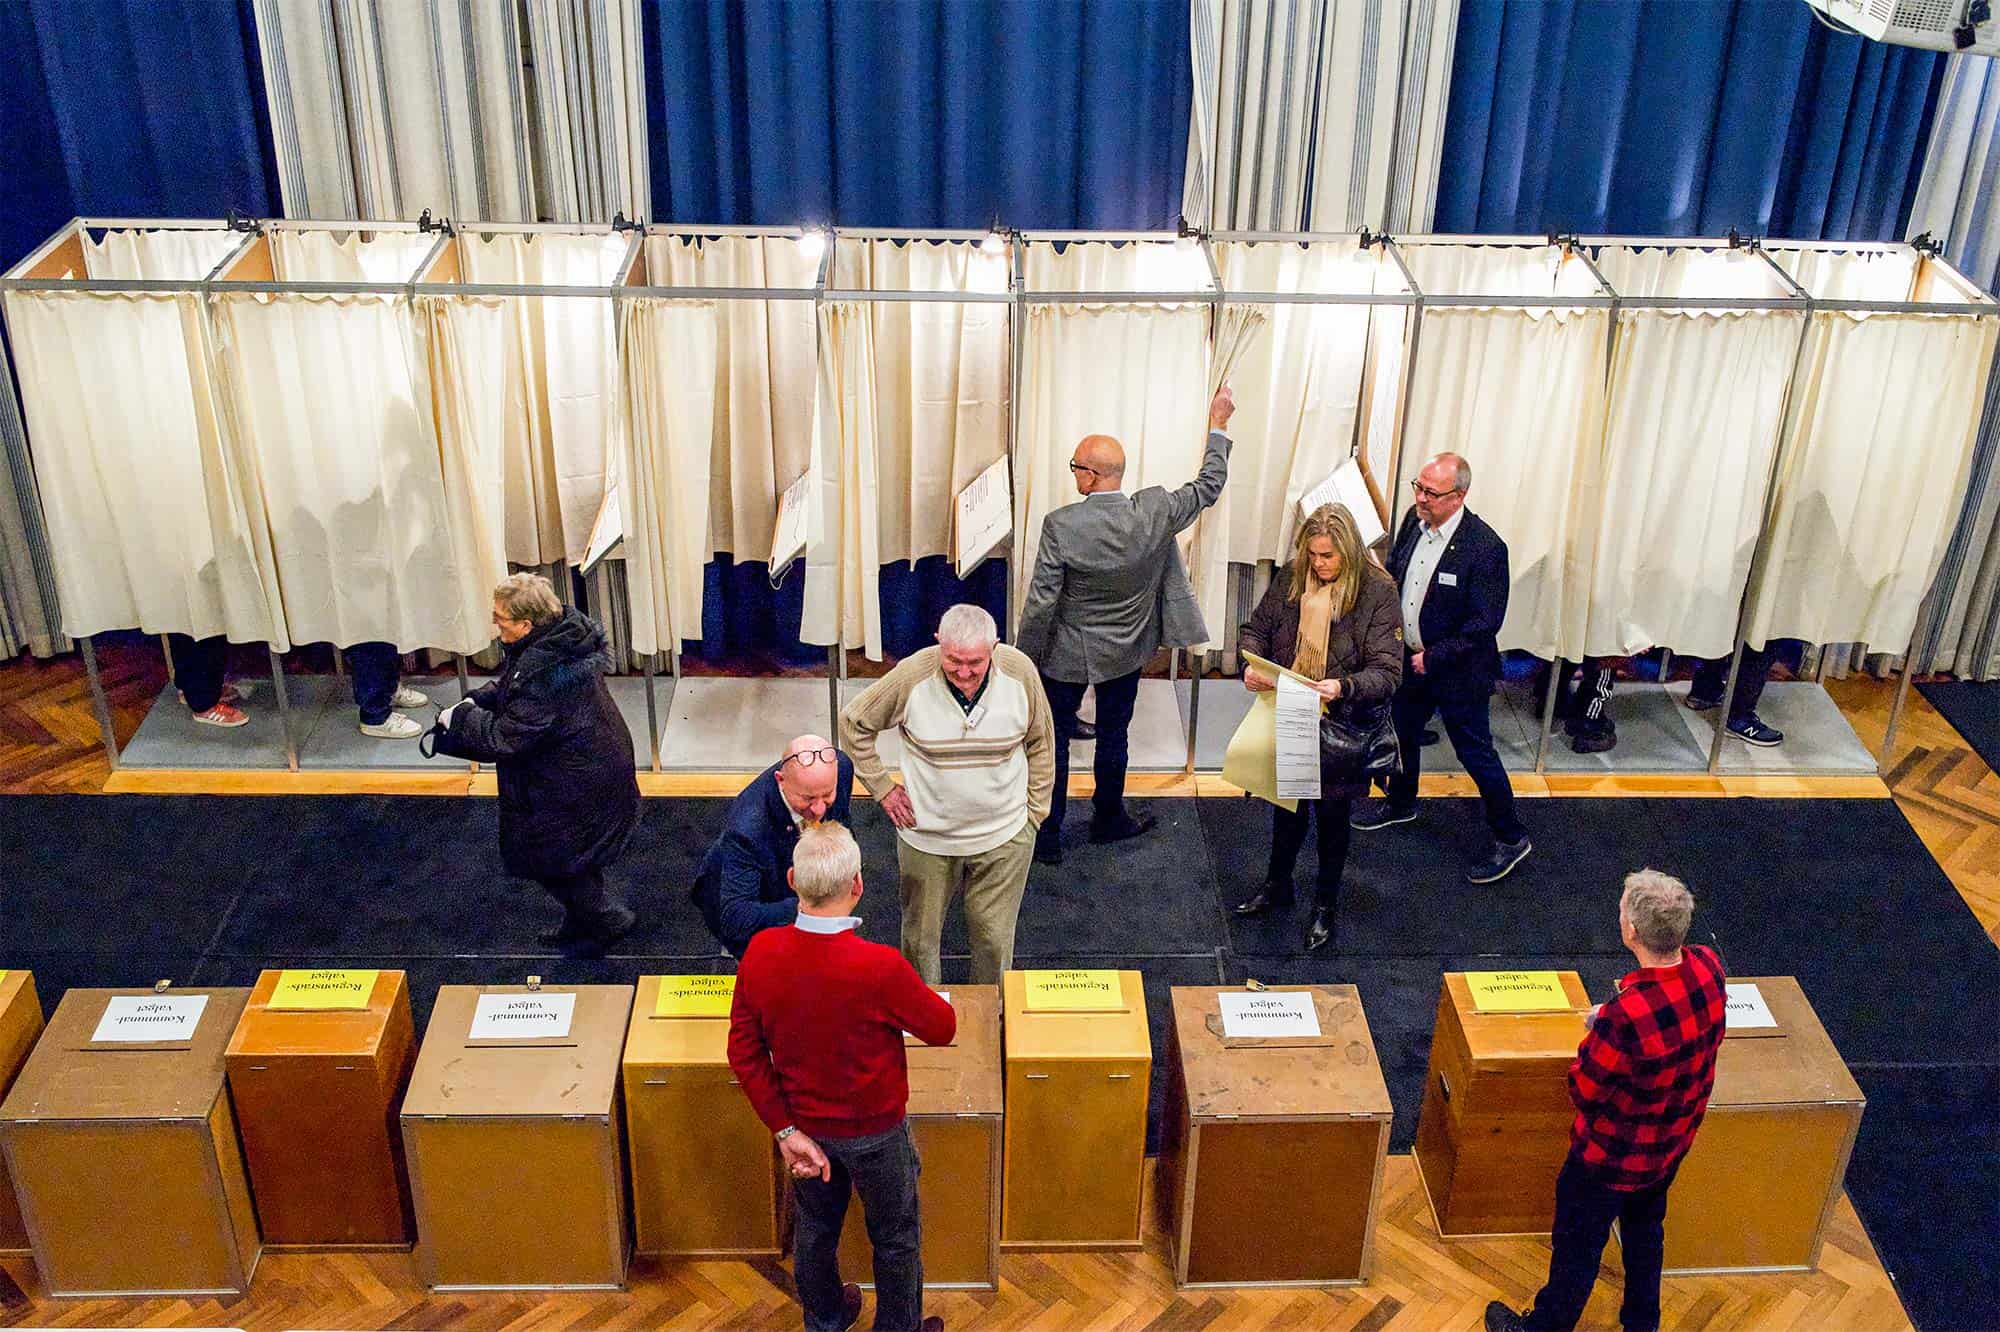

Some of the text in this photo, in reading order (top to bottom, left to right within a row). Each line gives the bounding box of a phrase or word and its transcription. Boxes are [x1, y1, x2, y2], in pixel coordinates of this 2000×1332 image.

[690, 977, 725, 987] valget
[136, 1003, 172, 1013] valget
[508, 1001, 543, 1010] valget
[1249, 1000, 1284, 1009] valget
[488, 1013, 558, 1021] Kommunal-
[1235, 1012, 1303, 1020] Kommunal-
